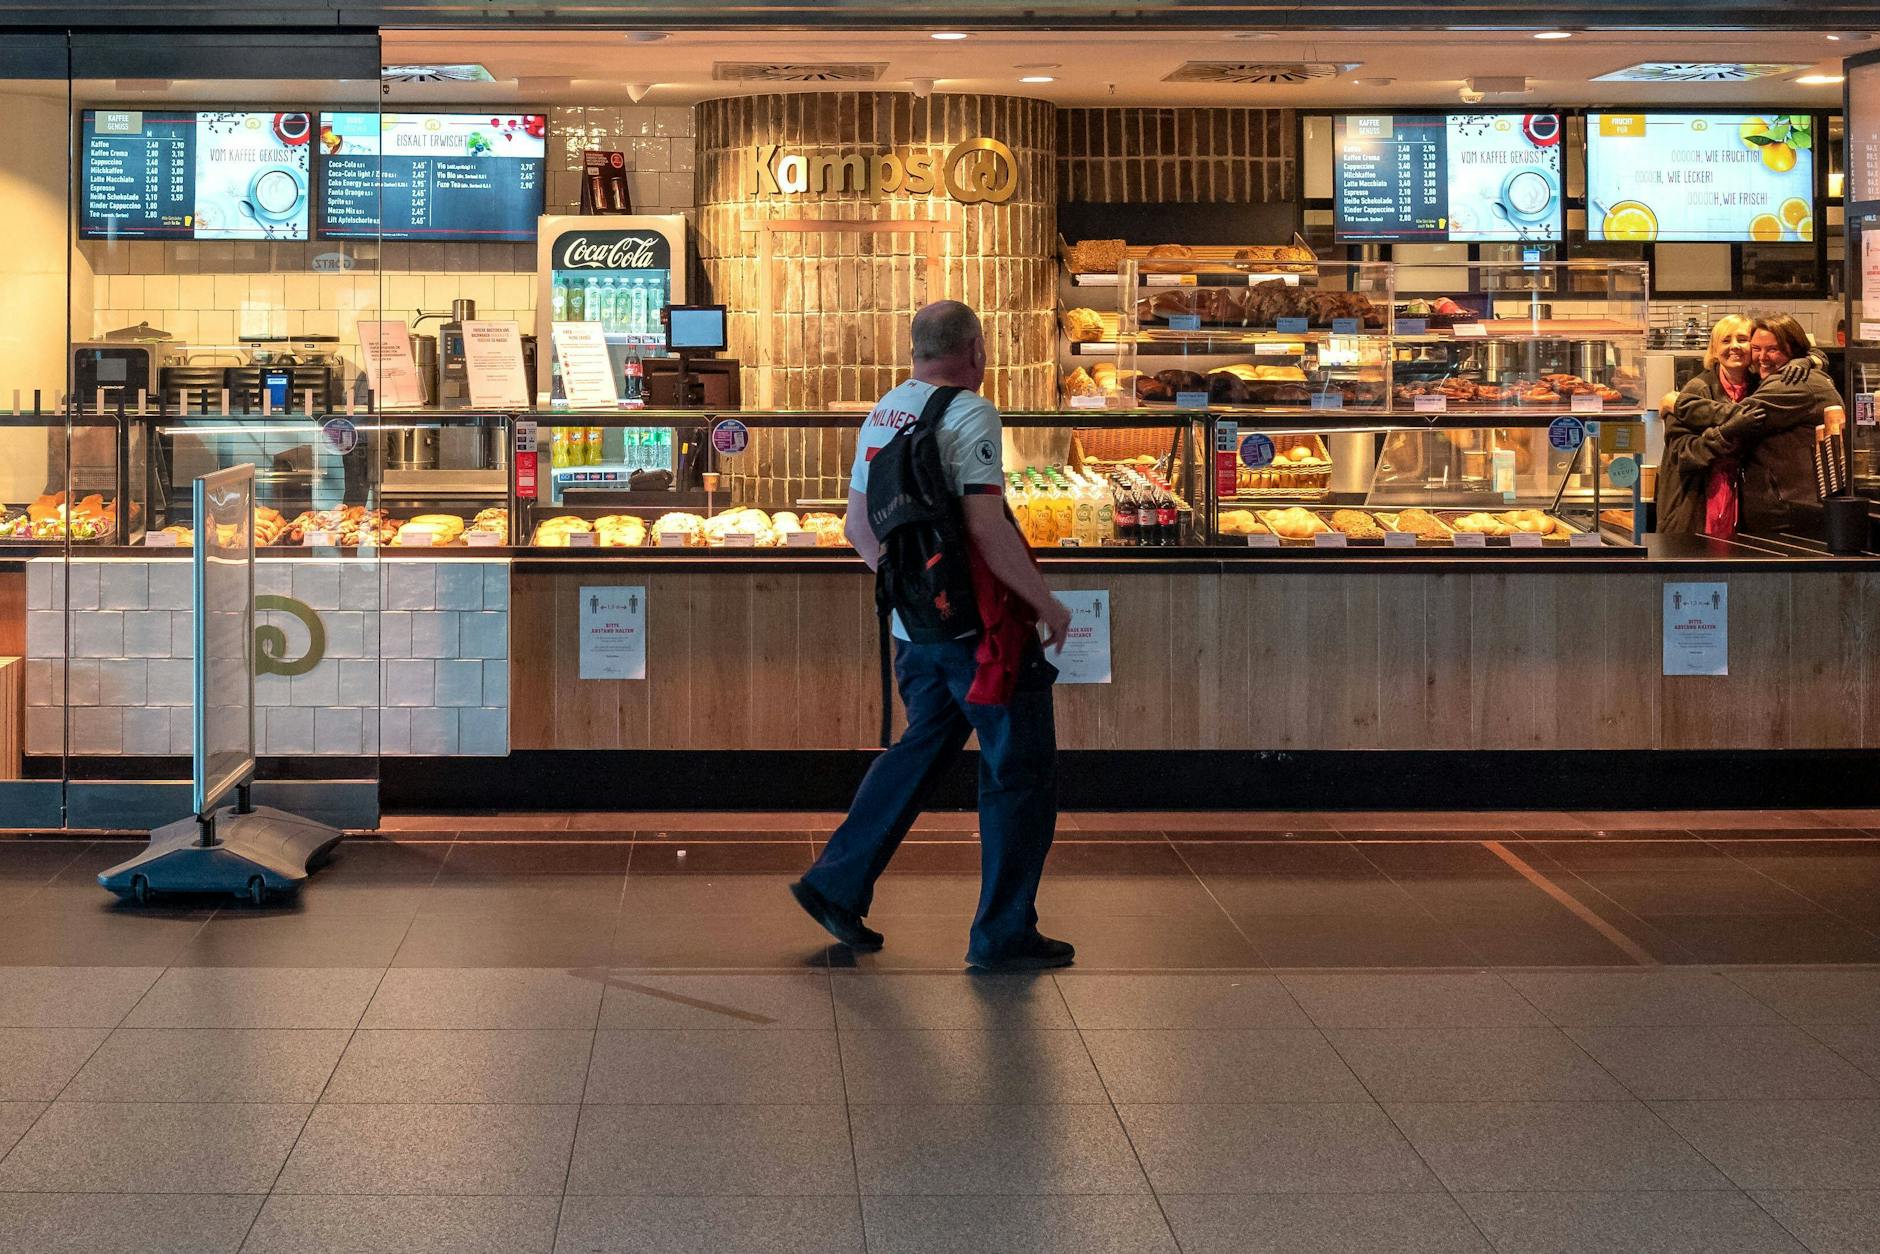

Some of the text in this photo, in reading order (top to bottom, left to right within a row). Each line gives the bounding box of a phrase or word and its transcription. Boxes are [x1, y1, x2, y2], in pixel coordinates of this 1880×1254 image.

[397, 134, 468, 148] EISKALT ERWISCHT
[210, 148, 226, 161] VOM
[229, 149, 256, 162] KAFFEE
[1461, 151, 1477, 164] VOM
[1480, 151, 1507, 164] KAFFEE
[1705, 150, 1718, 162] WIE
[1722, 150, 1760, 162] FRUCHTIG!
[91, 158, 122, 166] Cappuccino
[358, 170, 370, 178] light
[750, 144, 936, 205] Kamps
[1668, 171, 1680, 183] WIE
[1684, 171, 1713, 183] LECKER!
[343, 180, 362, 189] Energy
[345, 189, 364, 197] Orange
[1723, 192, 1736, 205] WIE
[1740, 192, 1768, 205] FRISCH!
[110, 202, 141, 210] Cappuccino
[328, 198, 344, 206] Sprite
[338, 216, 372, 225] Apfelschorle
[564, 237, 659, 268] Coca-Cola
